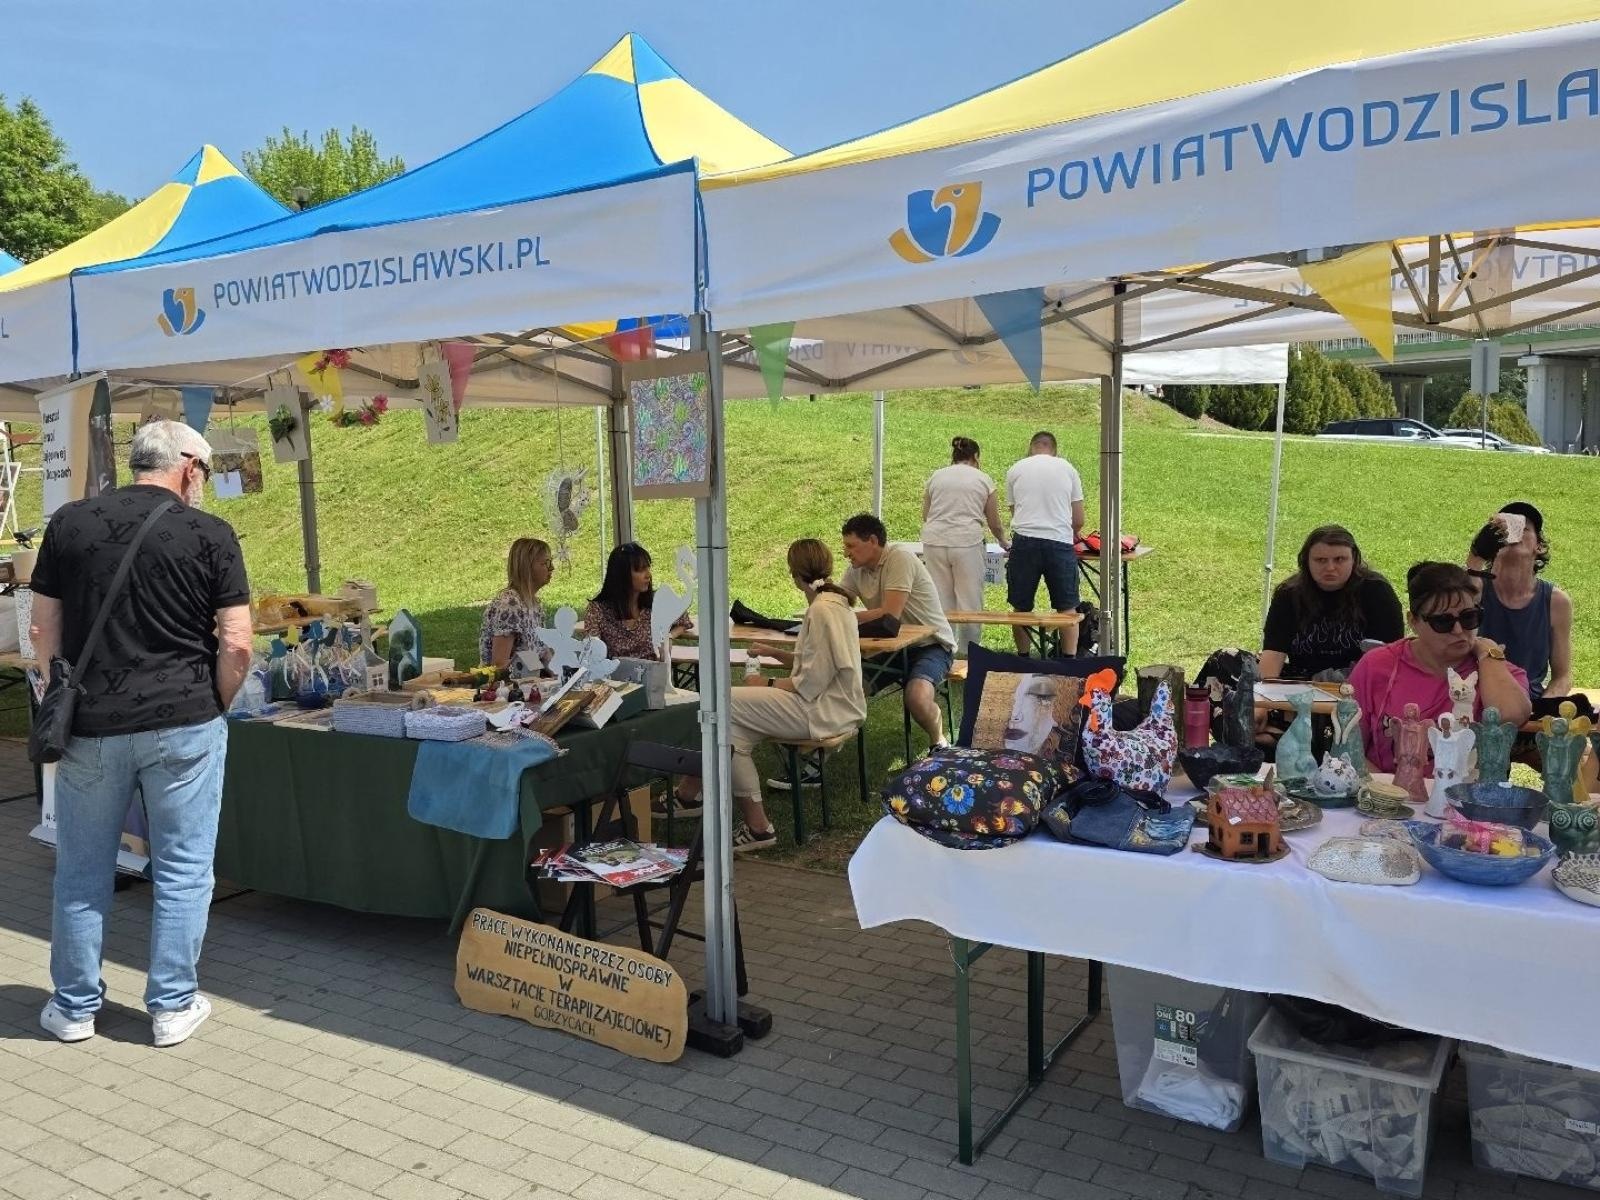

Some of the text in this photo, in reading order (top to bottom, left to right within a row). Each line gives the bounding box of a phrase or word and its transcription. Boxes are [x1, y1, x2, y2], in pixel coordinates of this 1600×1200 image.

[1026, 68, 1599, 207] POWIATWODZISLA
[213, 236, 550, 309] POWIATWODZISLAWSKI.PL
[472, 912, 672, 987] PRACE WYKONANE PRZEZ OSOBY
[504, 940, 630, 993] NIEPEŁNOSPRAWNE
[466, 963, 546, 1003] WARSZTACIE
[559, 974, 573, 992] W
[511, 998, 596, 1037] W GORZYCACH
[1175, 1009, 1195, 1025] 80
